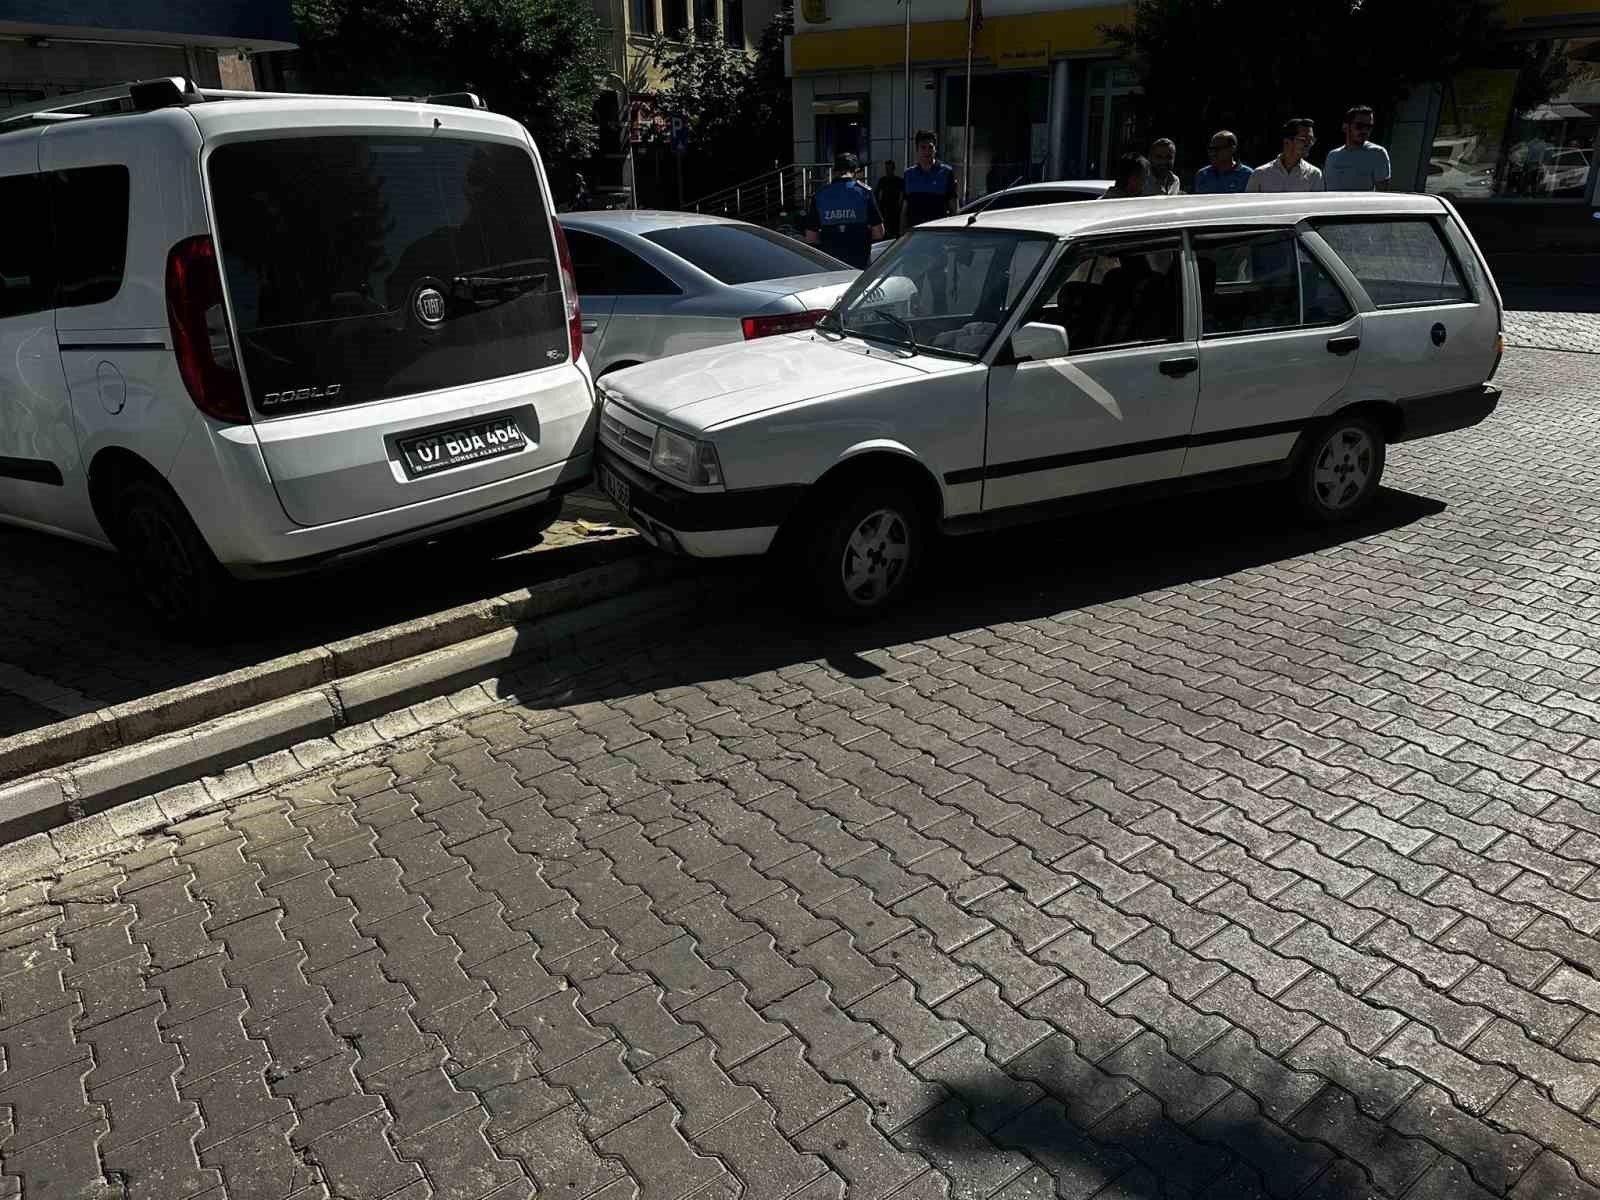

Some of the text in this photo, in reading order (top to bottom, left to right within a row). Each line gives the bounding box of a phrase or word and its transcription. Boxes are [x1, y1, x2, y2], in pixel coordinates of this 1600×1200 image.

[672, 117, 684, 137] P
[823, 208, 857, 220] ZABITA
[422, 298, 441, 315] FIAT
[416, 419, 520, 462] 07 BDA 464
